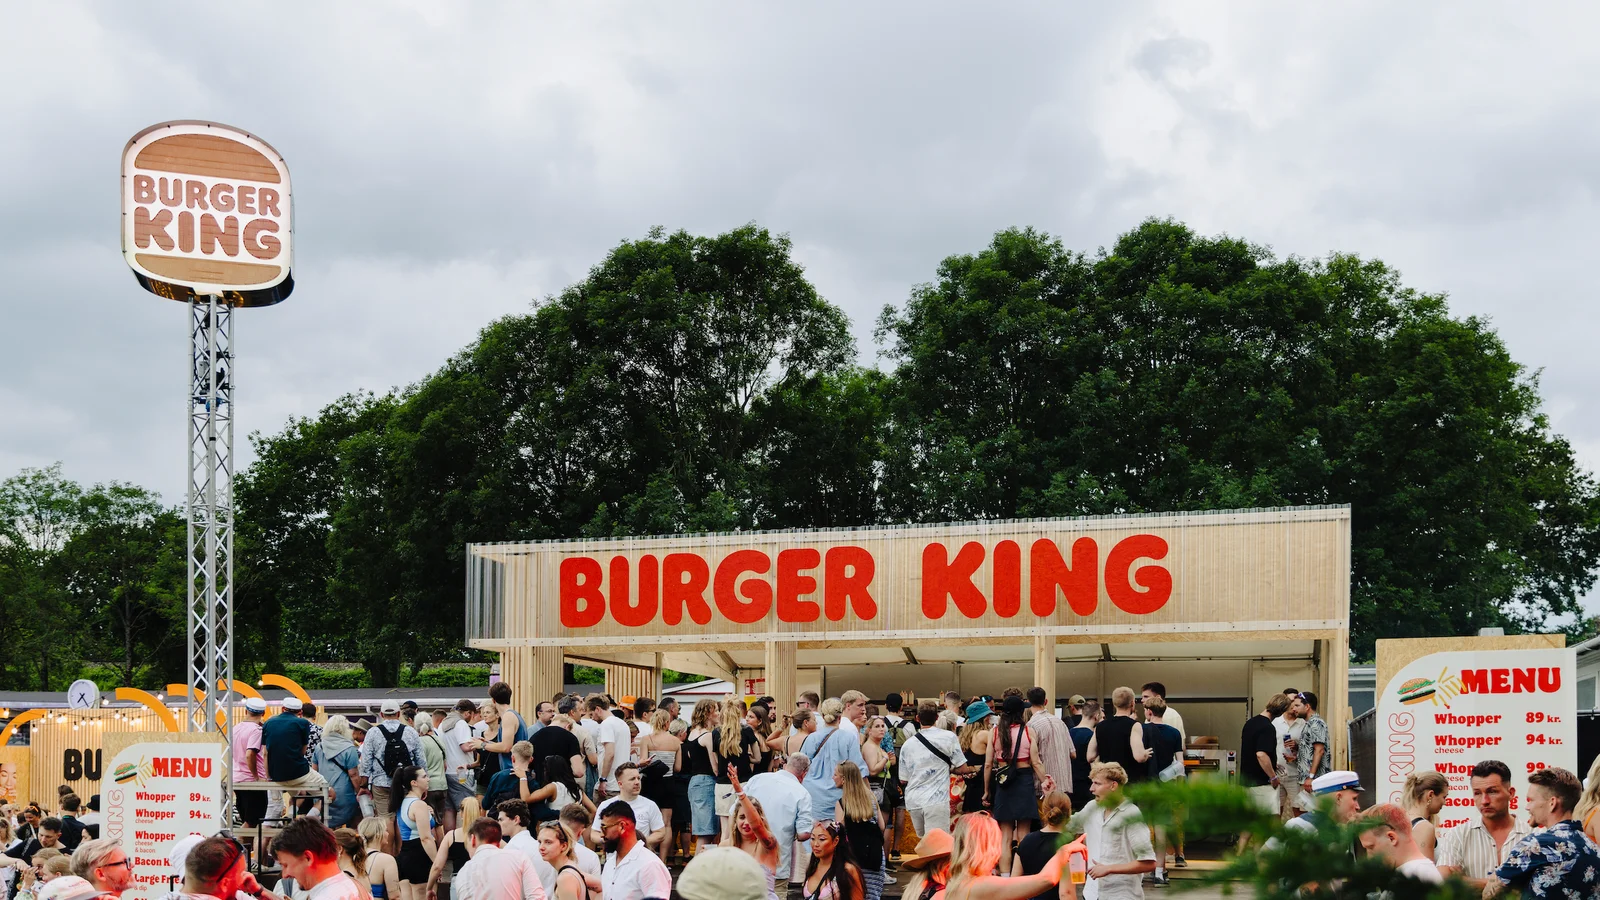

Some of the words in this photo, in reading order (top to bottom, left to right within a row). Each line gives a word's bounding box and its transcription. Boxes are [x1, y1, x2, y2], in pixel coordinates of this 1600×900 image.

[133, 174, 282, 218] BURGER
[134, 206, 282, 260] KING
[559, 546, 877, 628] BURGER
[921, 534, 1173, 619] KING
[1460, 667, 1562, 694] MENU
[1434, 713, 1502, 726] Whopper
[1525, 711, 1544, 723] 89
[1547, 715, 1561, 723] kr.
[1388, 712, 1415, 783] KING
[1434, 734, 1502, 748] Whopper
[1526, 733, 1546, 745] 94
[1549, 737, 1563, 745] kr.
[64, 748, 102, 781] BU
[152, 757, 212, 778] MENU
[135, 791, 175, 803] Whopper
[189, 793, 201, 802] 89
[135, 808, 175, 820] Whopper
[189, 810, 201, 819] 94
[135, 831, 175, 842] Whopper
[134, 857, 162, 866] Bacon
